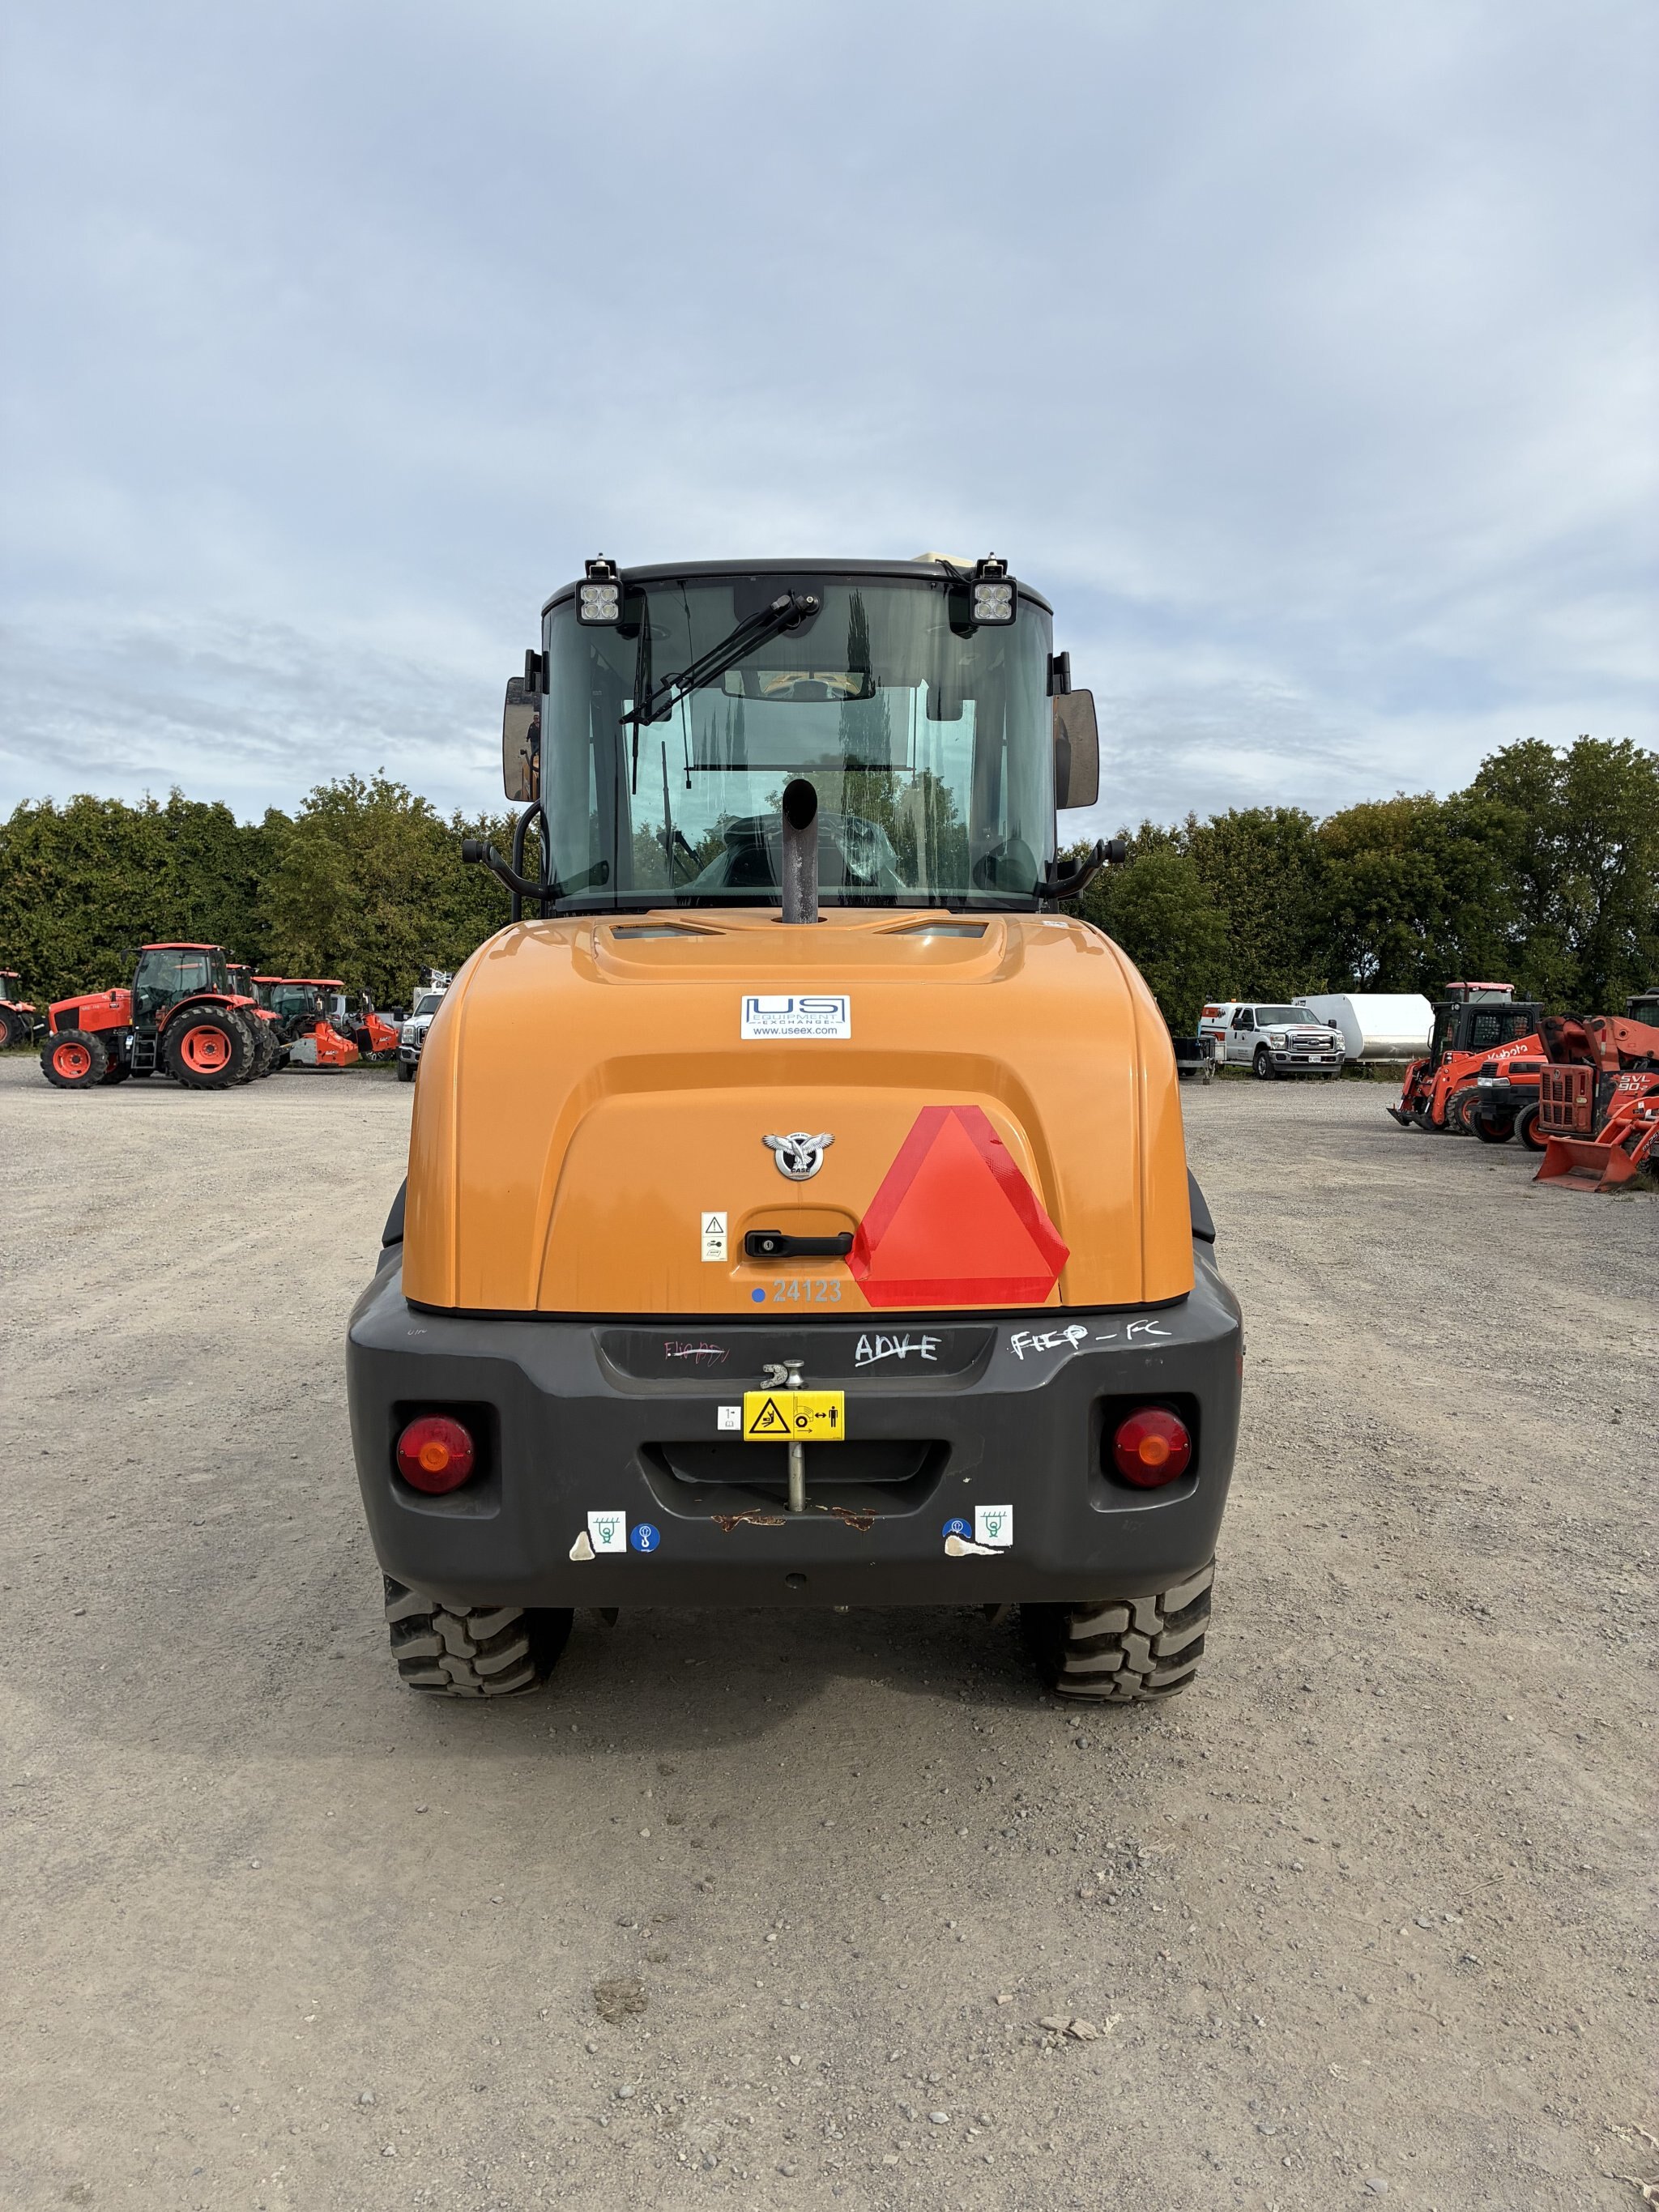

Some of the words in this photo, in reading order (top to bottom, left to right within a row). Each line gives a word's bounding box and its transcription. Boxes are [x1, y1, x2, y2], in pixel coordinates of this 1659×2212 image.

[747, 999, 844, 1014] US
[753, 1027, 838, 1035] www.useex.com
[1620, 1075, 1651, 1083] SVL
[1618, 1082, 1648, 1092] 90-2
[773, 1279, 842, 1302] 24123
